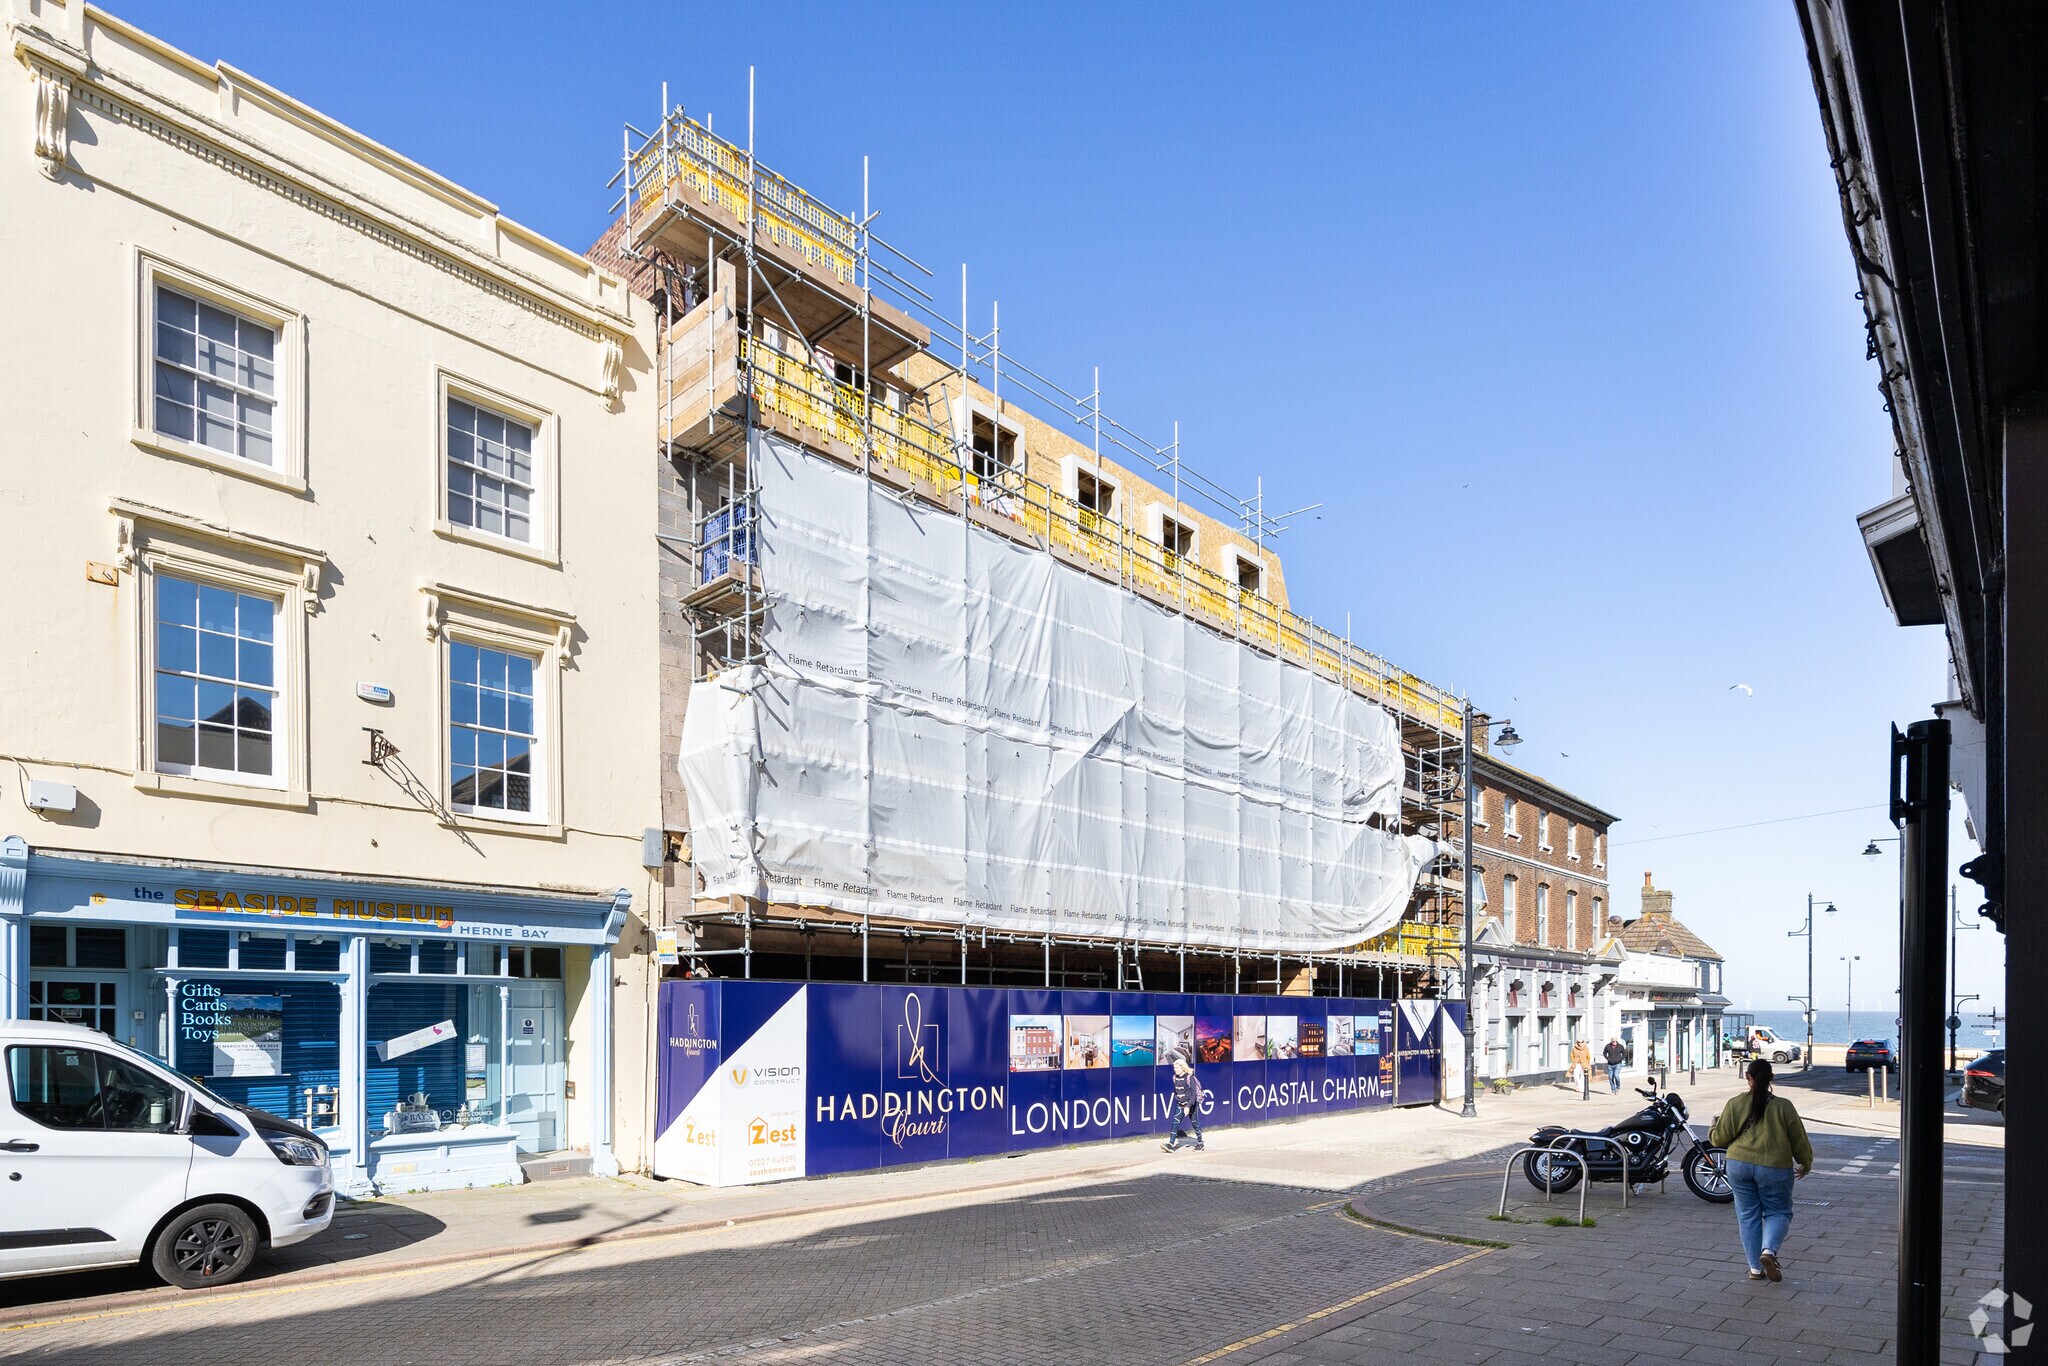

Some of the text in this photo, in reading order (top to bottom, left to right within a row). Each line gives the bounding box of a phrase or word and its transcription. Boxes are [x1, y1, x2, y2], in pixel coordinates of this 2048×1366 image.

[788, 654, 858, 677] Flame Retardant
[931, 692, 988, 712] Flame Retardant
[994, 708, 1041, 727] Flame Retardant
[1064, 726, 1093, 739] Retardant
[764, 872, 802, 885] Retardant
[814, 878, 879, 897] Flame Retardant
[886, 890, 944, 905] Flame Retardant
[953, 897, 1003, 911] Flame Retardant
[133, 886, 164, 900] the
[174, 888, 318, 917] SEASIDE
[332, 898, 454, 924] MUSEUM
[1010, 904, 1057, 917] Flame Retardant
[1063, 909, 1107, 921] Flame Retardant
[460, 926, 550, 939] HERNE BAY
[181, 983, 221, 997] Gifts
[181, 998, 227, 1011] Cards
[181, 1012, 232, 1025] Books
[181, 1026, 220, 1042] Toys
[670, 1037, 717, 1049] HADDINGTON
[754, 1067, 800, 1078] VISION
[754, 1078, 800, 1086] CONSTRUCT
[817, 1086, 1004, 1123] HADDINGTON
[1012, 1096, 1130, 1136] LONDON
[1141, 1089, 1214, 1121] LIVG
[1238, 1080, 1318, 1111] COASTAL
[1322, 1075, 1380, 1101] CHARM
[686, 1123, 716, 1147] Zest
[752, 1124, 797, 1145] Zest
[881, 1107, 947, 1149] Court
[748, 1158, 770, 1167] 01227
[749, 1166, 796, 1176] zesthomes.uk
